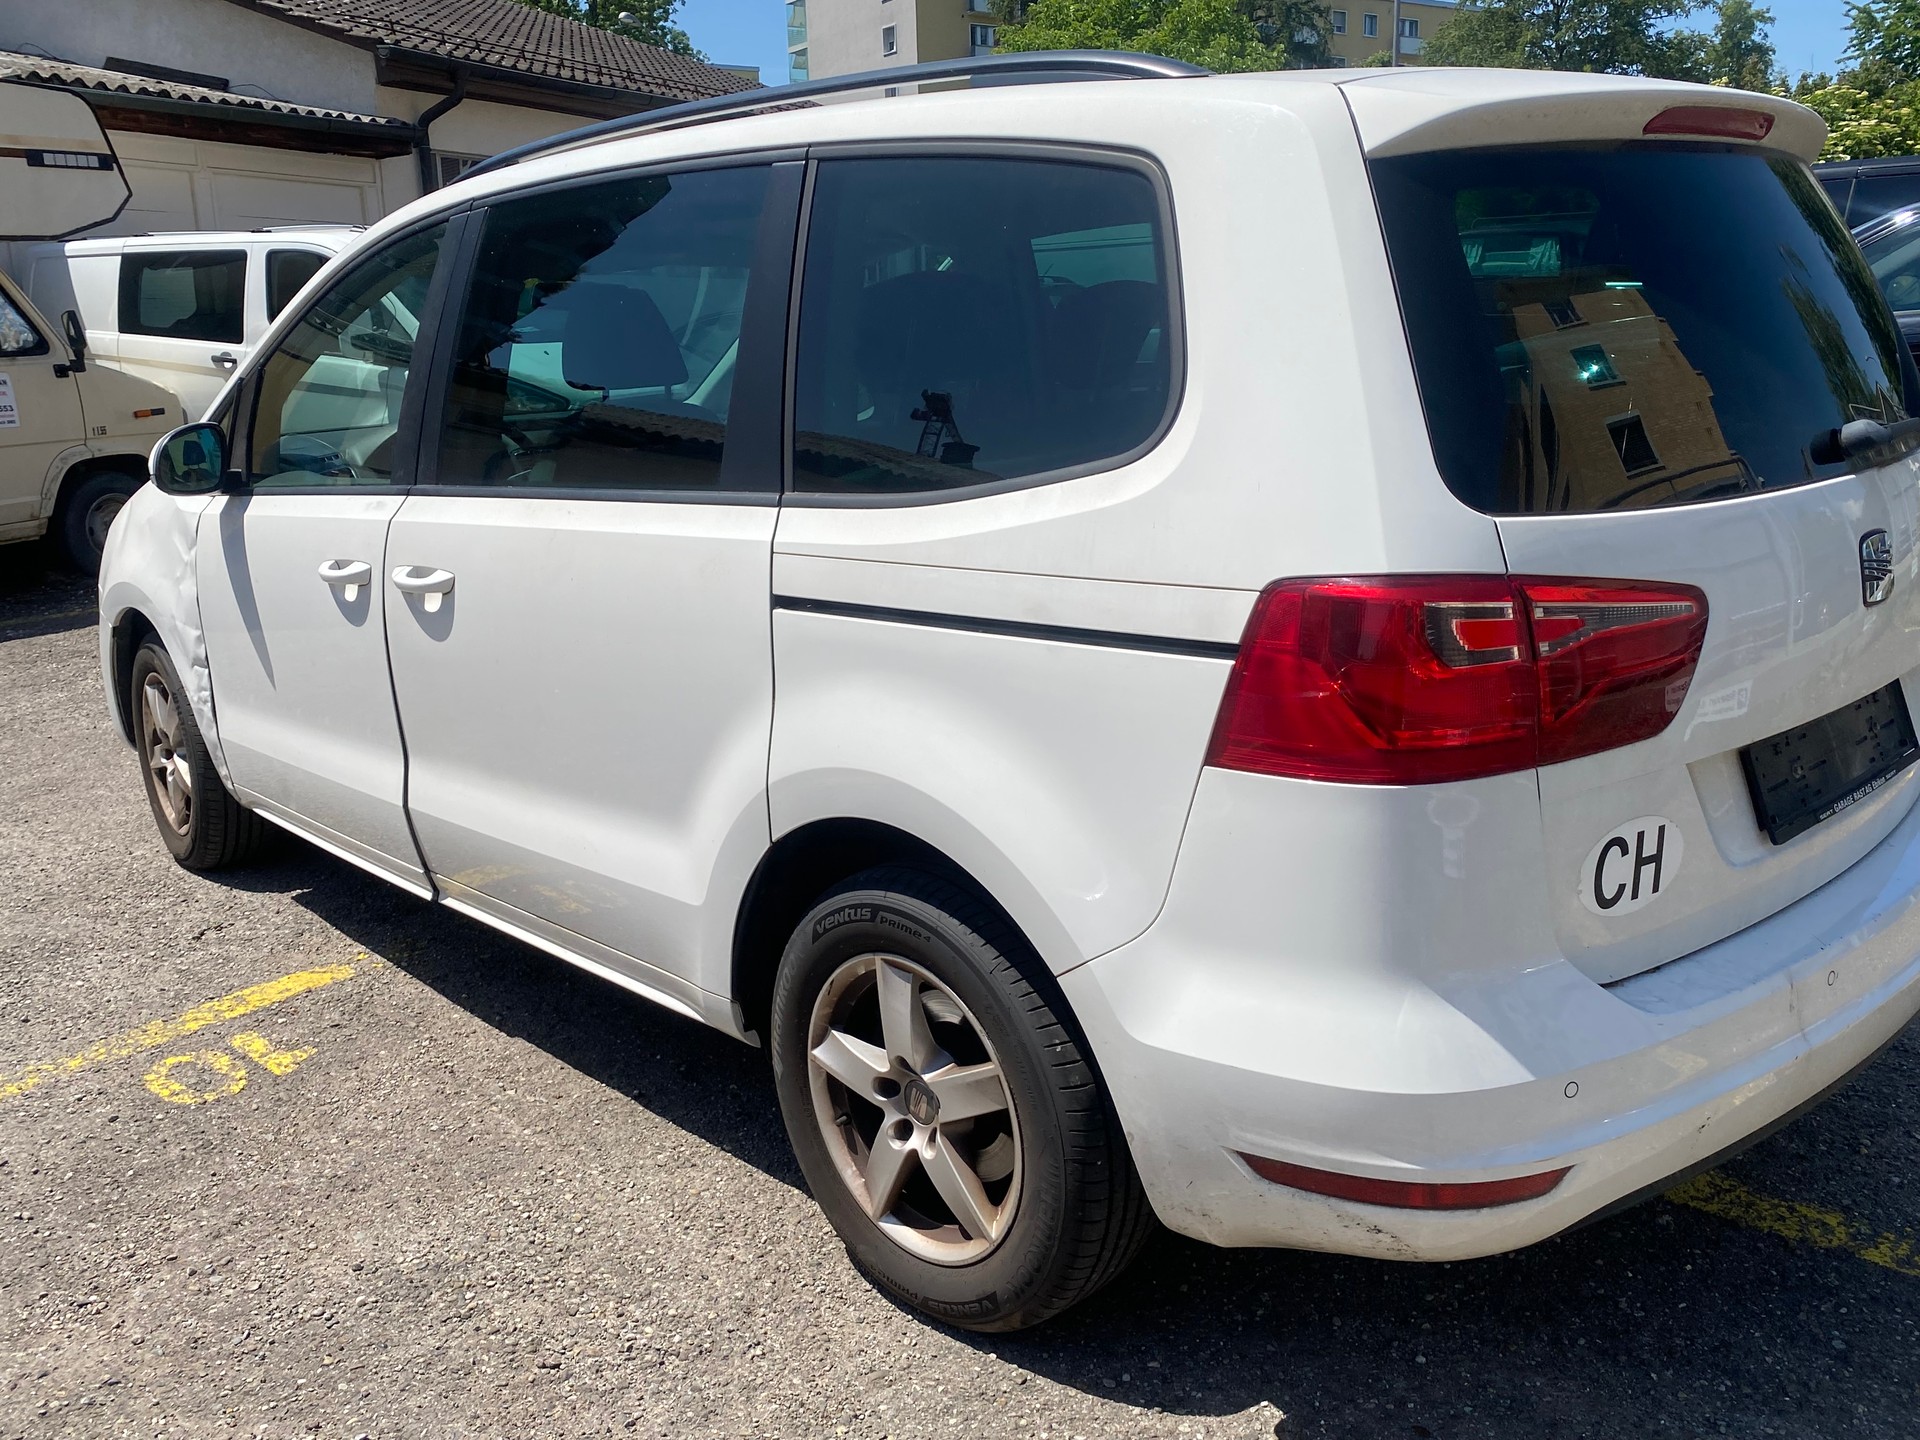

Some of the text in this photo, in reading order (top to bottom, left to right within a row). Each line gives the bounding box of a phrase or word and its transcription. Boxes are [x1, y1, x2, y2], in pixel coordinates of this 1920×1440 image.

[1833, 795, 1854, 812] GARAGE
[1853, 789, 1866, 801] RAST
[1593, 824, 1666, 910] CH
